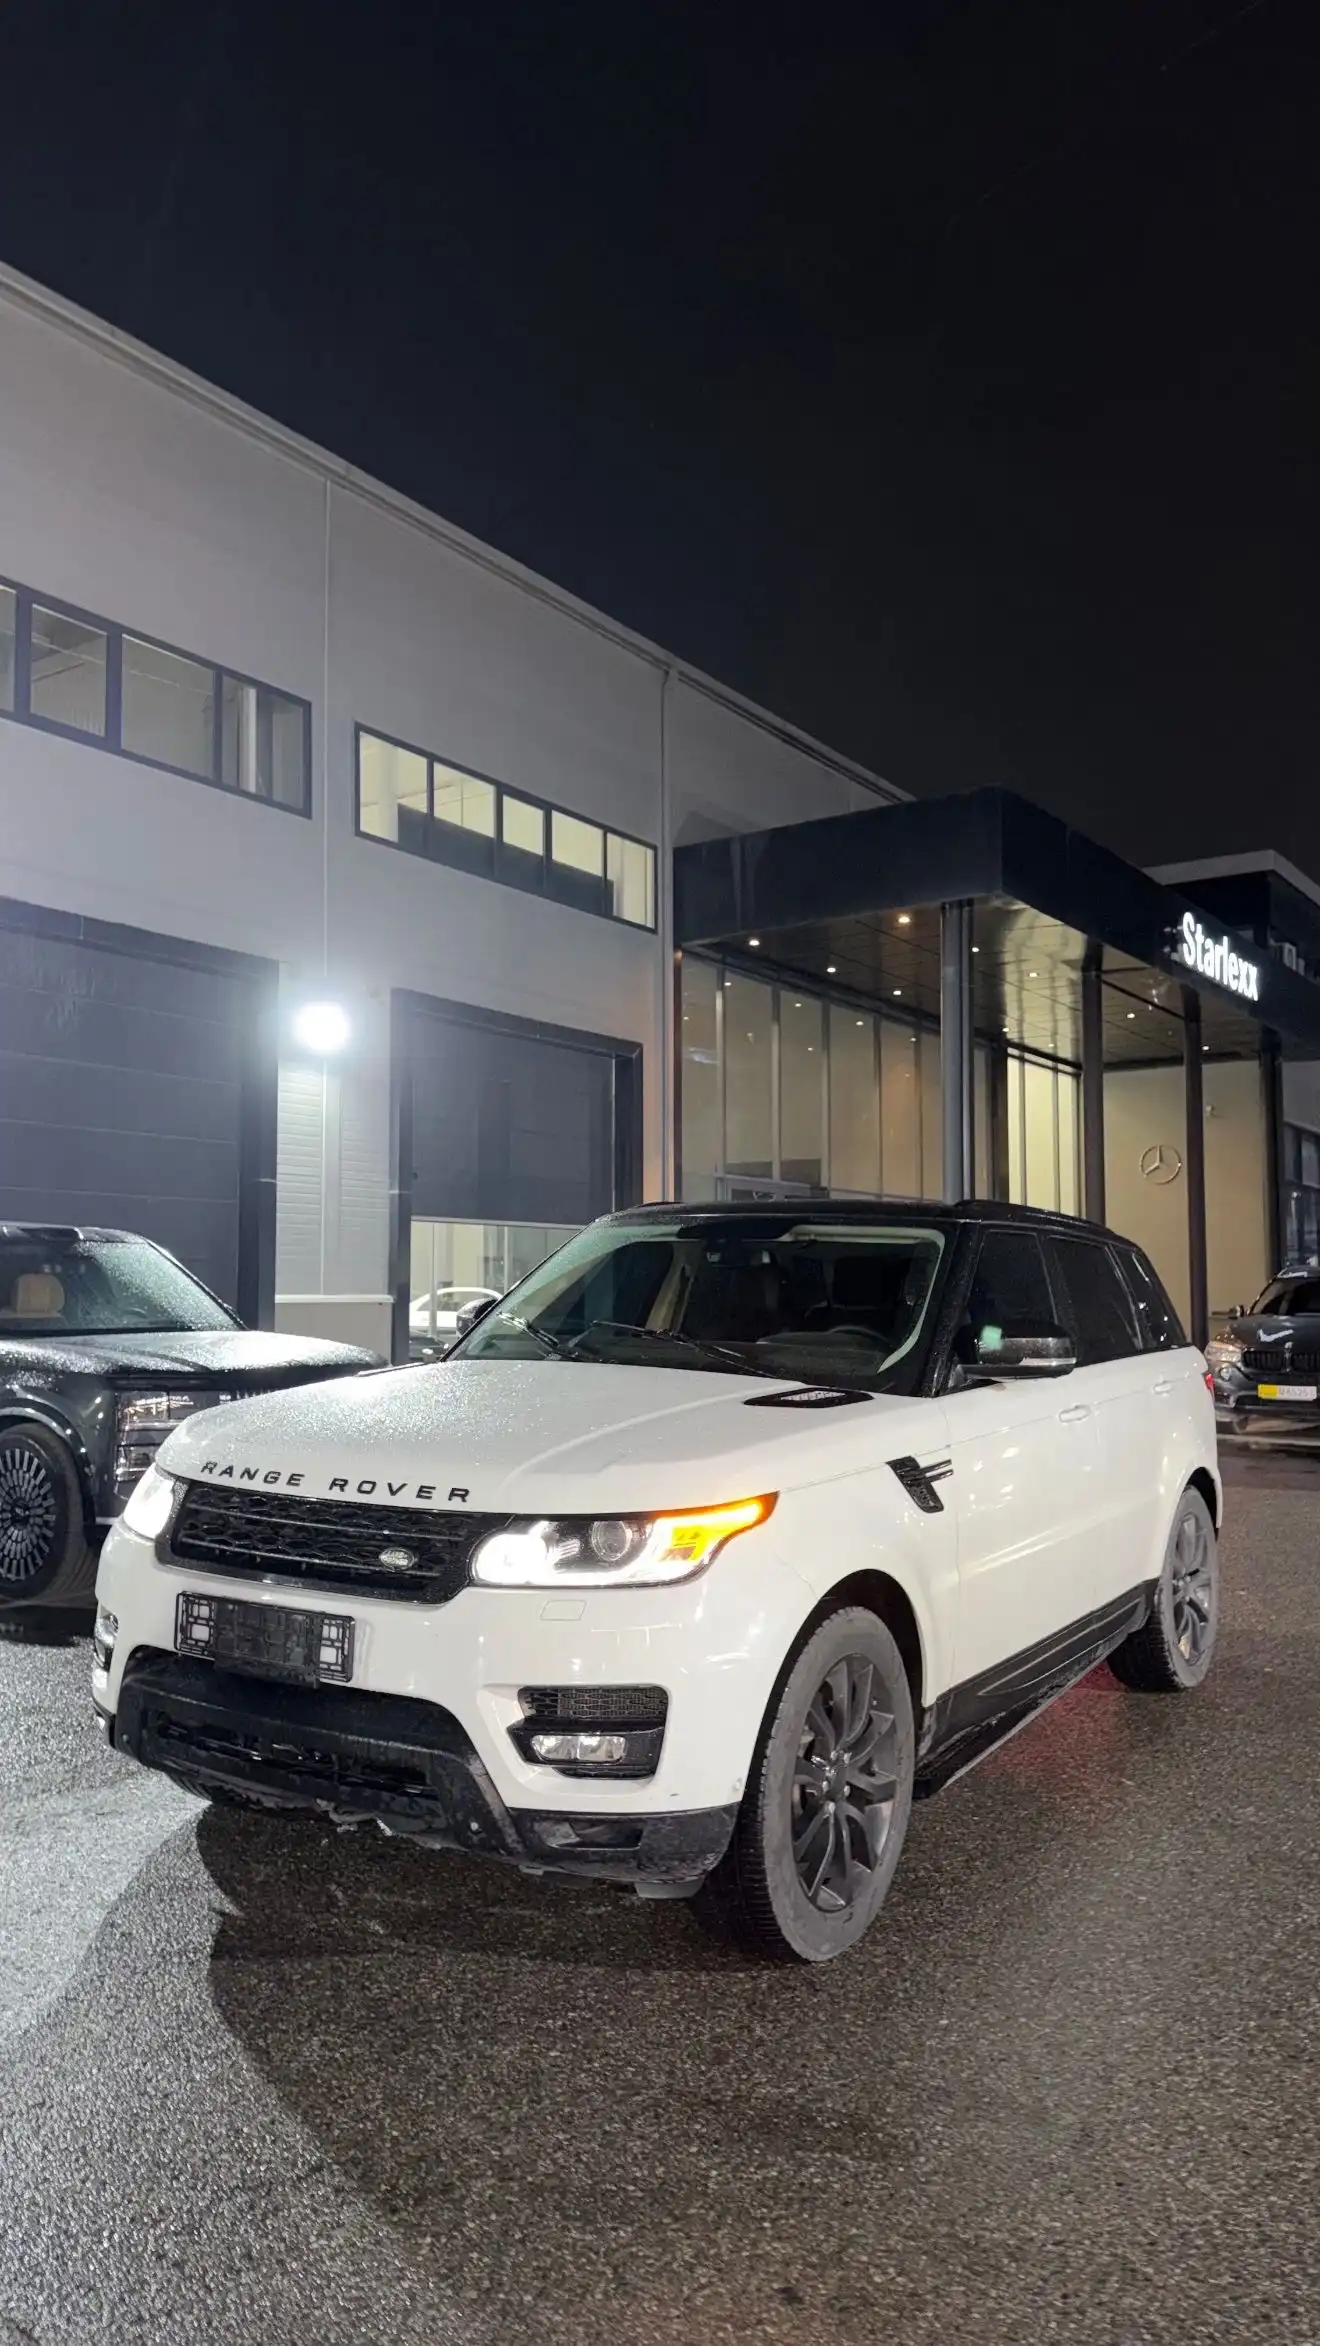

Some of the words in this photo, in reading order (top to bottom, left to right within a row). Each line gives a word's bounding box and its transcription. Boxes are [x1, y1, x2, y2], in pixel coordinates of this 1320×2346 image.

[1182, 911, 1259, 1002] Starlexx
[200, 1461, 305, 1488] RANGE
[328, 1477, 471, 1502] ROVER
